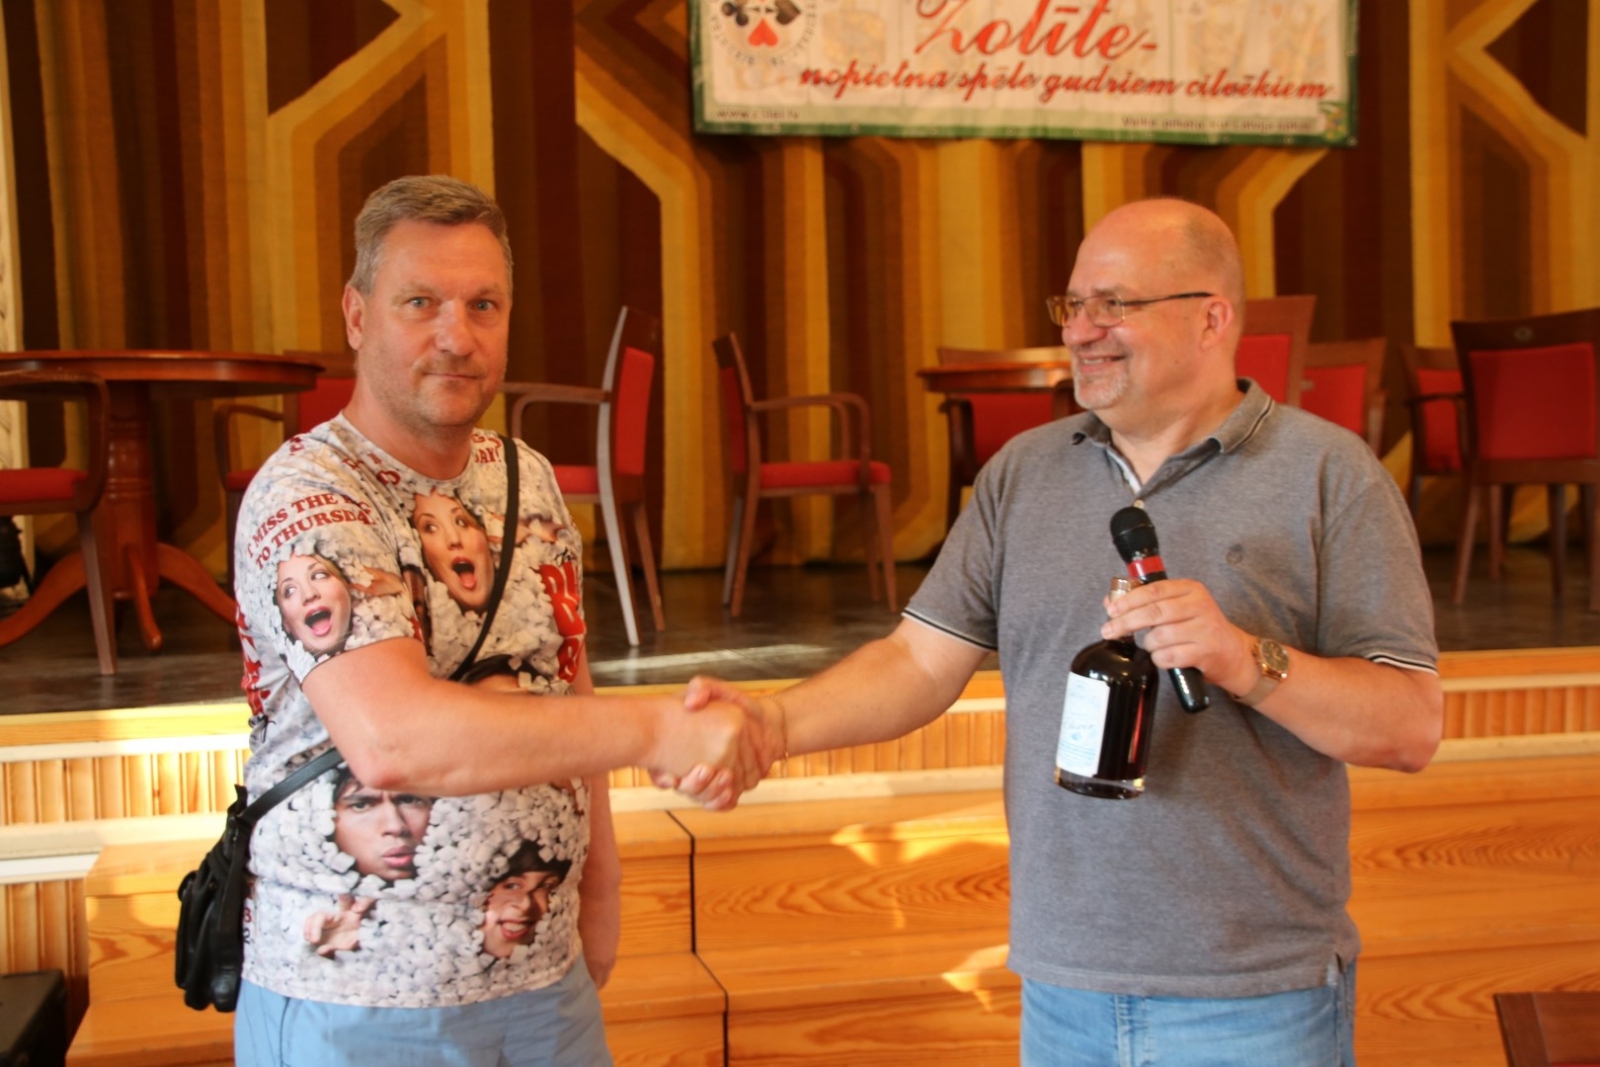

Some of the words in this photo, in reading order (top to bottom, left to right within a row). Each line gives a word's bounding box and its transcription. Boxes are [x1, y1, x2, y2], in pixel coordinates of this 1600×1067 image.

[798, 59, 949, 100] nopietna
[957, 62, 1037, 102] spēle
[1041, 67, 1178, 104] gudriem
[1185, 69, 1330, 98] cilvēkiem
[252, 508, 288, 548] MISS
[291, 492, 338, 515] THE
[255, 546, 271, 571] TO
